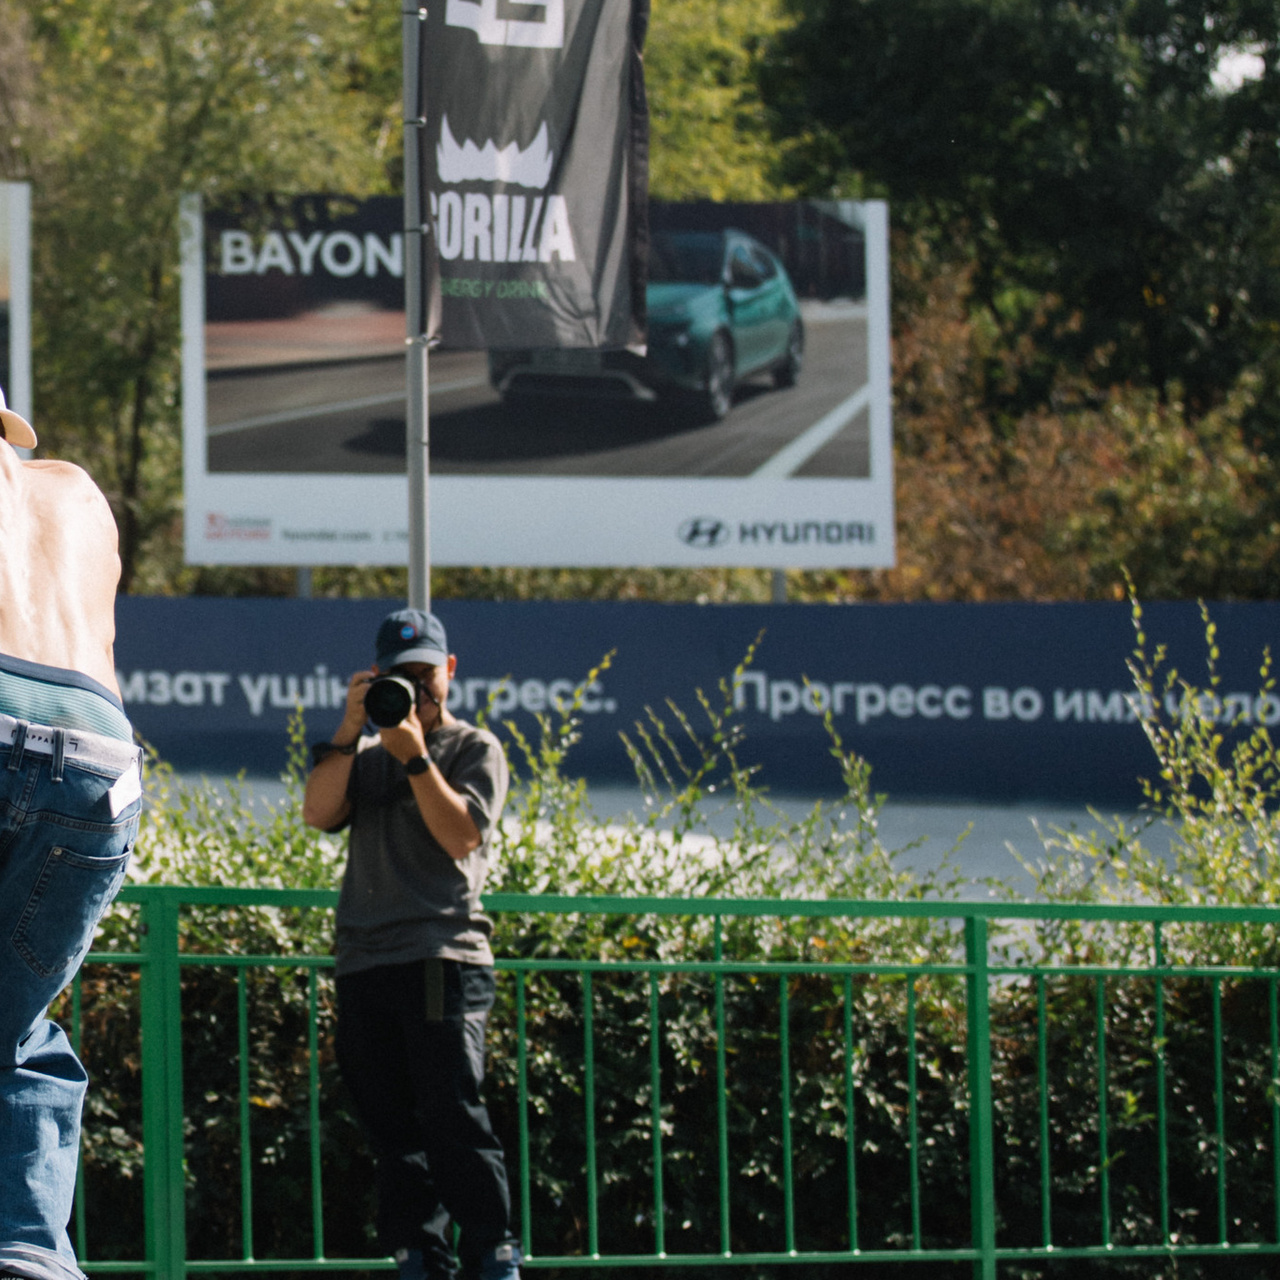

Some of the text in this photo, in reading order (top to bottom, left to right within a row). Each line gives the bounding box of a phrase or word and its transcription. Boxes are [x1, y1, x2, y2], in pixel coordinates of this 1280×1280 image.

[222, 231, 404, 276] BAYON
[739, 524, 876, 546] HYUNDAI
[115, 669, 230, 706] мзат
[449, 677, 617, 719] огресс.
[732, 670, 973, 722] Прогресс
[983, 686, 1043, 718] во
